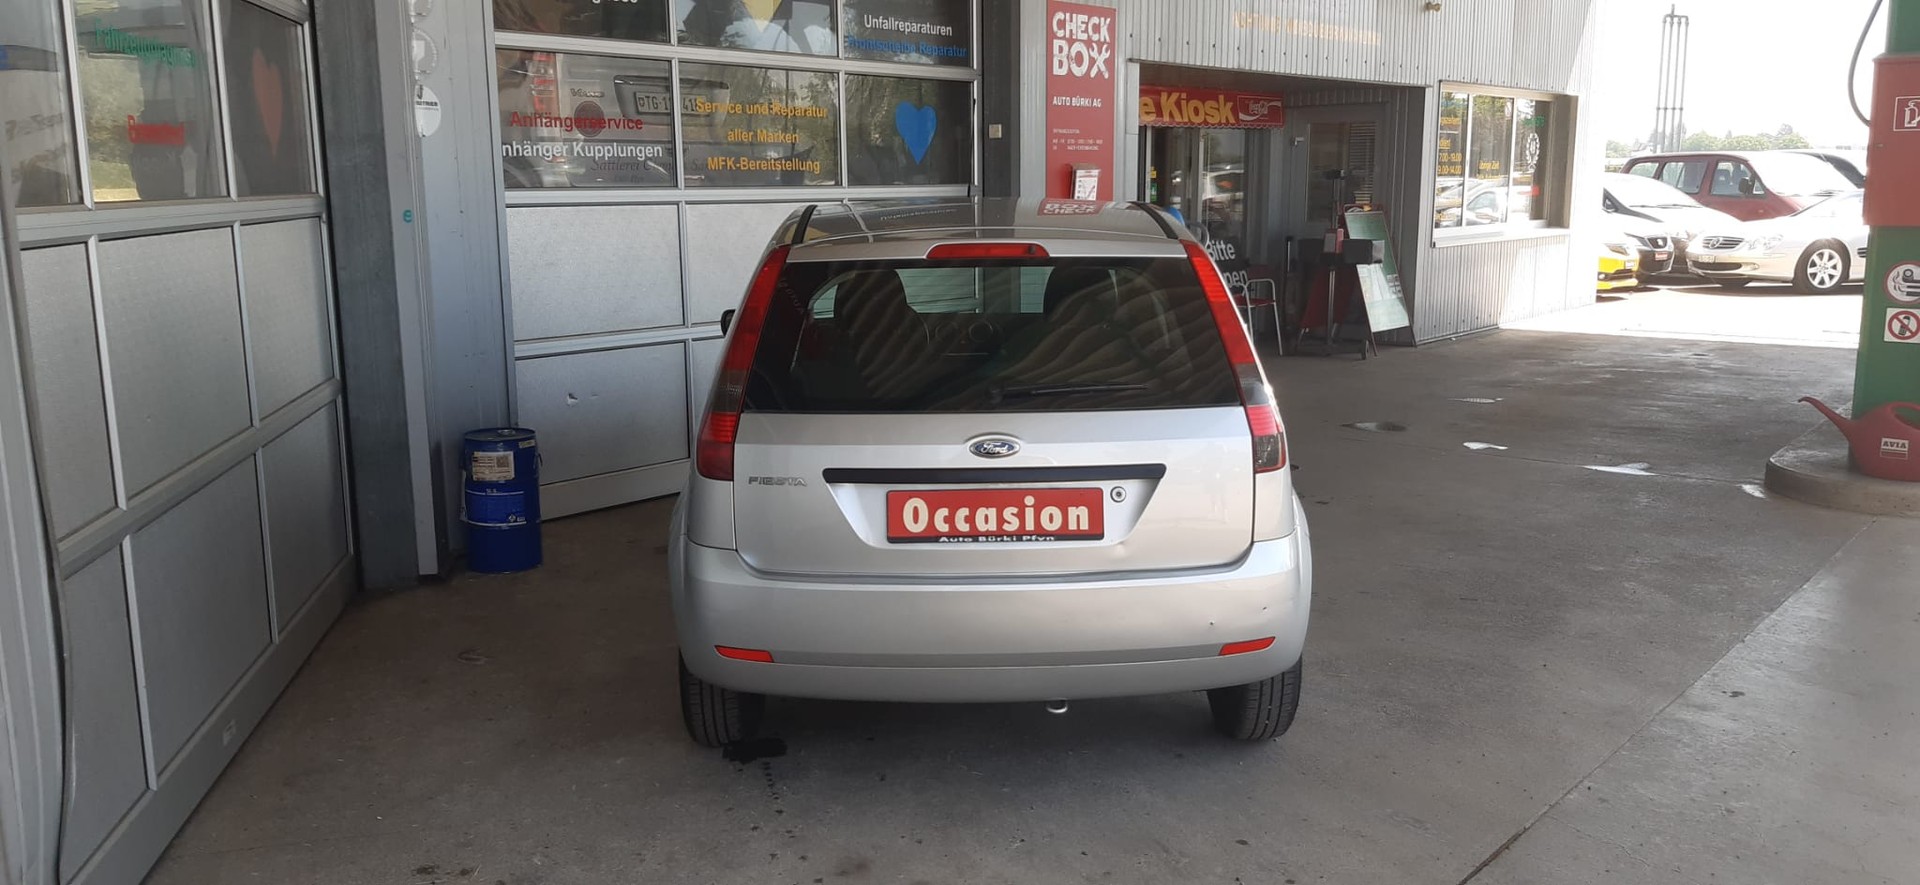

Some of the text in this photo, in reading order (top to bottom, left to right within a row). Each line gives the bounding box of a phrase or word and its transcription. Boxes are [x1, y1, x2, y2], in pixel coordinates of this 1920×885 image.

[864, 14, 953, 37] Unfallreparaturen
[1052, 11, 1111, 43] CHECK
[919, 42, 968, 57] Reparatur
[1052, 39, 1111, 79] BOX
[696, 96, 829, 118] Service und Reparatur
[1053, 95, 1102, 108] AUTO BÜRKI AG
[1160, 91, 1236, 124] Kiosk
[510, 111, 644, 133] Anhängerservice
[727, 128, 801, 144] aller Marken
[573, 141, 663, 161] Kupplungen
[707, 156, 821, 174] MFK-Bereitstellung
[1206, 239, 1236, 261] Bitte
[980, 440, 1009, 454] Ford
[1882, 440, 1907, 449] AVIA
[748, 476, 808, 487] FIESTA
[902, 495, 1090, 533] Occasion
[938, 535, 973, 543] Auto
[1022, 534, 1055, 542] Pfyn
